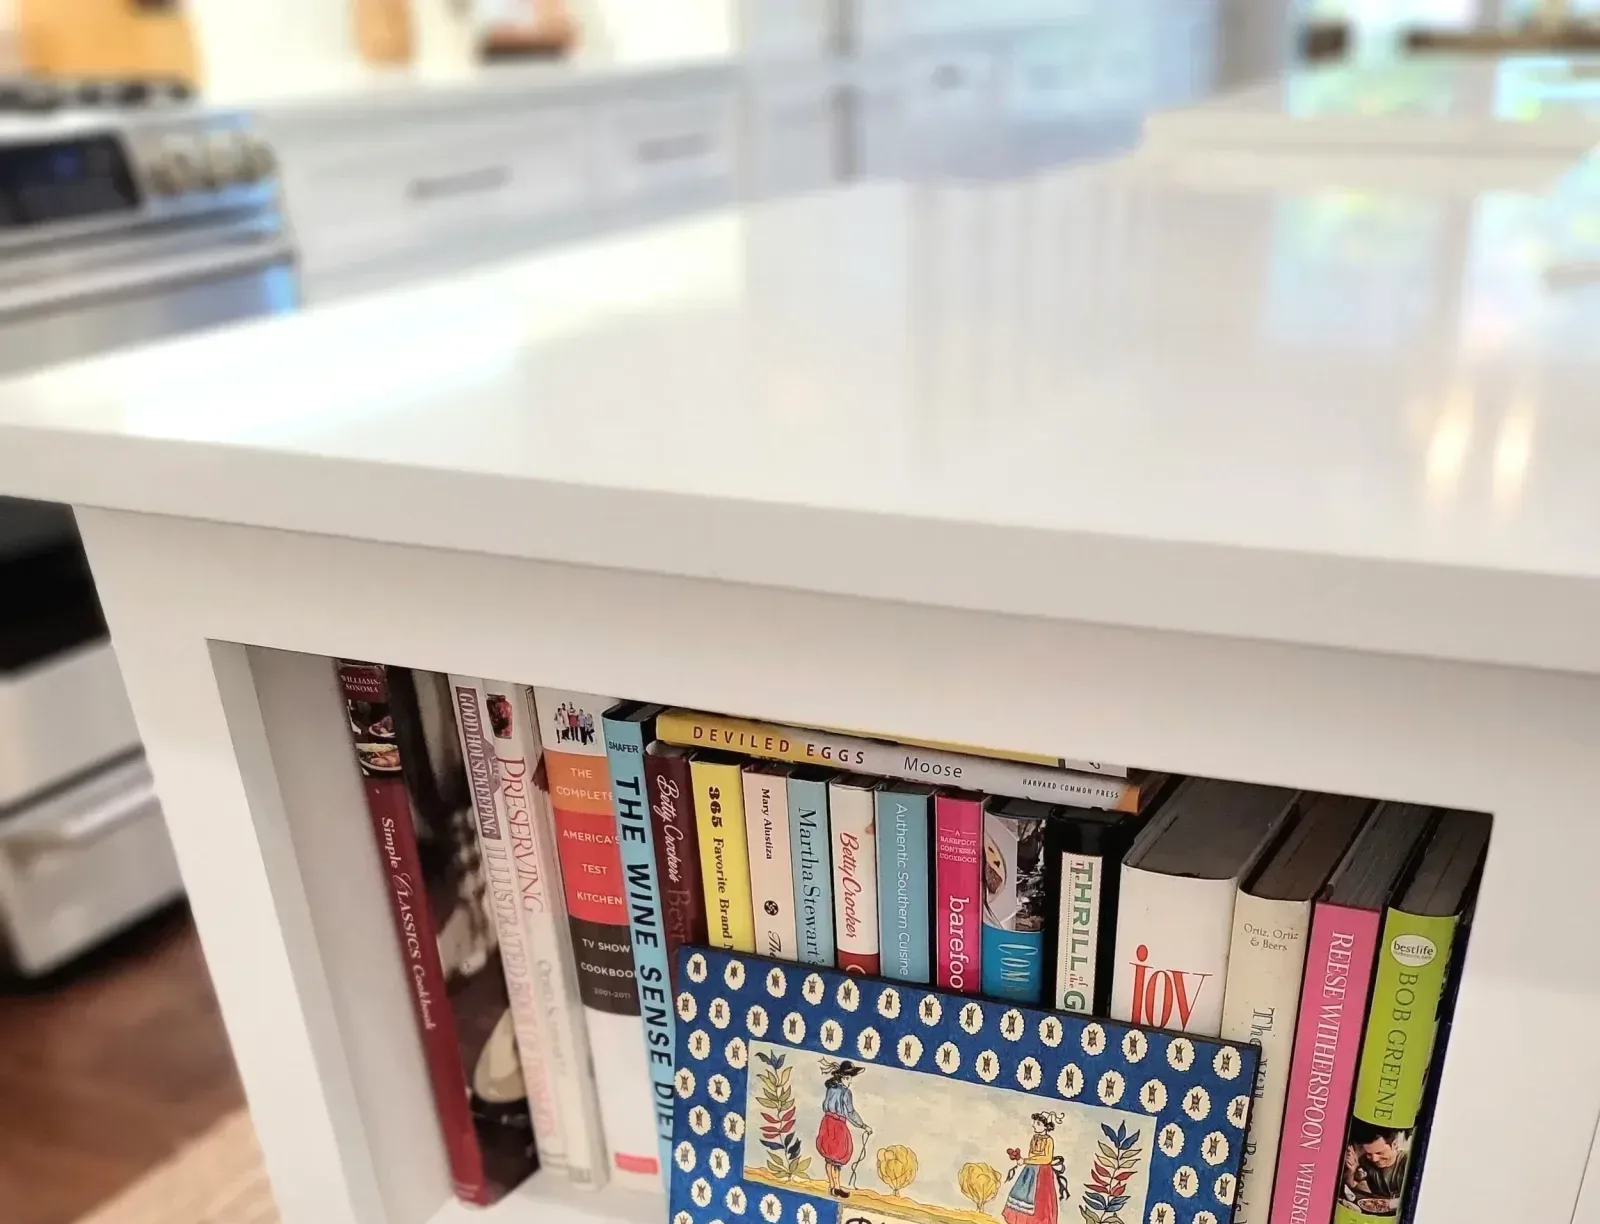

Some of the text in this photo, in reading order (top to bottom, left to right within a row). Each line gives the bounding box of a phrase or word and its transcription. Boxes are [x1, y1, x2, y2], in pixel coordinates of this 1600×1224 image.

[345, 683, 379, 693] SONOMA
[458, 692, 498, 837] GOOD HOUSEKEEPING
[608, 741, 639, 754] SHAFER
[693, 726, 865, 765] DEVILED EGGS
[903, 756, 963, 779] Moose
[570, 767, 593, 779] THE
[653, 774, 680, 822] Betty
[1022, 778, 1119, 800] HARVARD COMMON PRESS
[616, 776, 647, 844] THE
[708, 786, 723, 828] 365
[761, 788, 773, 860] Mary Alustiza
[498, 756, 544, 914] PRESERVING
[663, 824, 684, 883] Crocker's
[798, 808, 820, 881] Martha
[940, 853, 977, 863] COOKBOOK
[581, 863, 608, 875] TEST
[713, 837, 728, 893] Favorite
[838, 832, 862, 938] Betty Crocker
[896, 803, 909, 976] Authentic Southern Cuisine
[576, 891, 623, 905] KITCHEN
[626, 863, 659, 948] WINE
[719, 898, 733, 939] Brand
[1069, 862, 1094, 971] THRILL
[382, 817, 402, 868] Simple
[413, 964, 436, 1030] Cookbook
[581, 938, 631, 954] TV SHOW
[949, 895, 969, 992] barefoo
[1272, 929, 1299, 940] Ortiz
[1393, 940, 1434, 956] bestlife
[580, 961, 637, 978] COOKBOO
[1079, 976, 1088, 988] of
[1322, 931, 1355, 1000] REESE
[640, 964, 673, 1068] SENSE
[1392, 972, 1419, 1022] BOB
[1300, 1003, 1343, 1152] WITHERSPOON
[1373, 1030, 1408, 1122] GREENE
